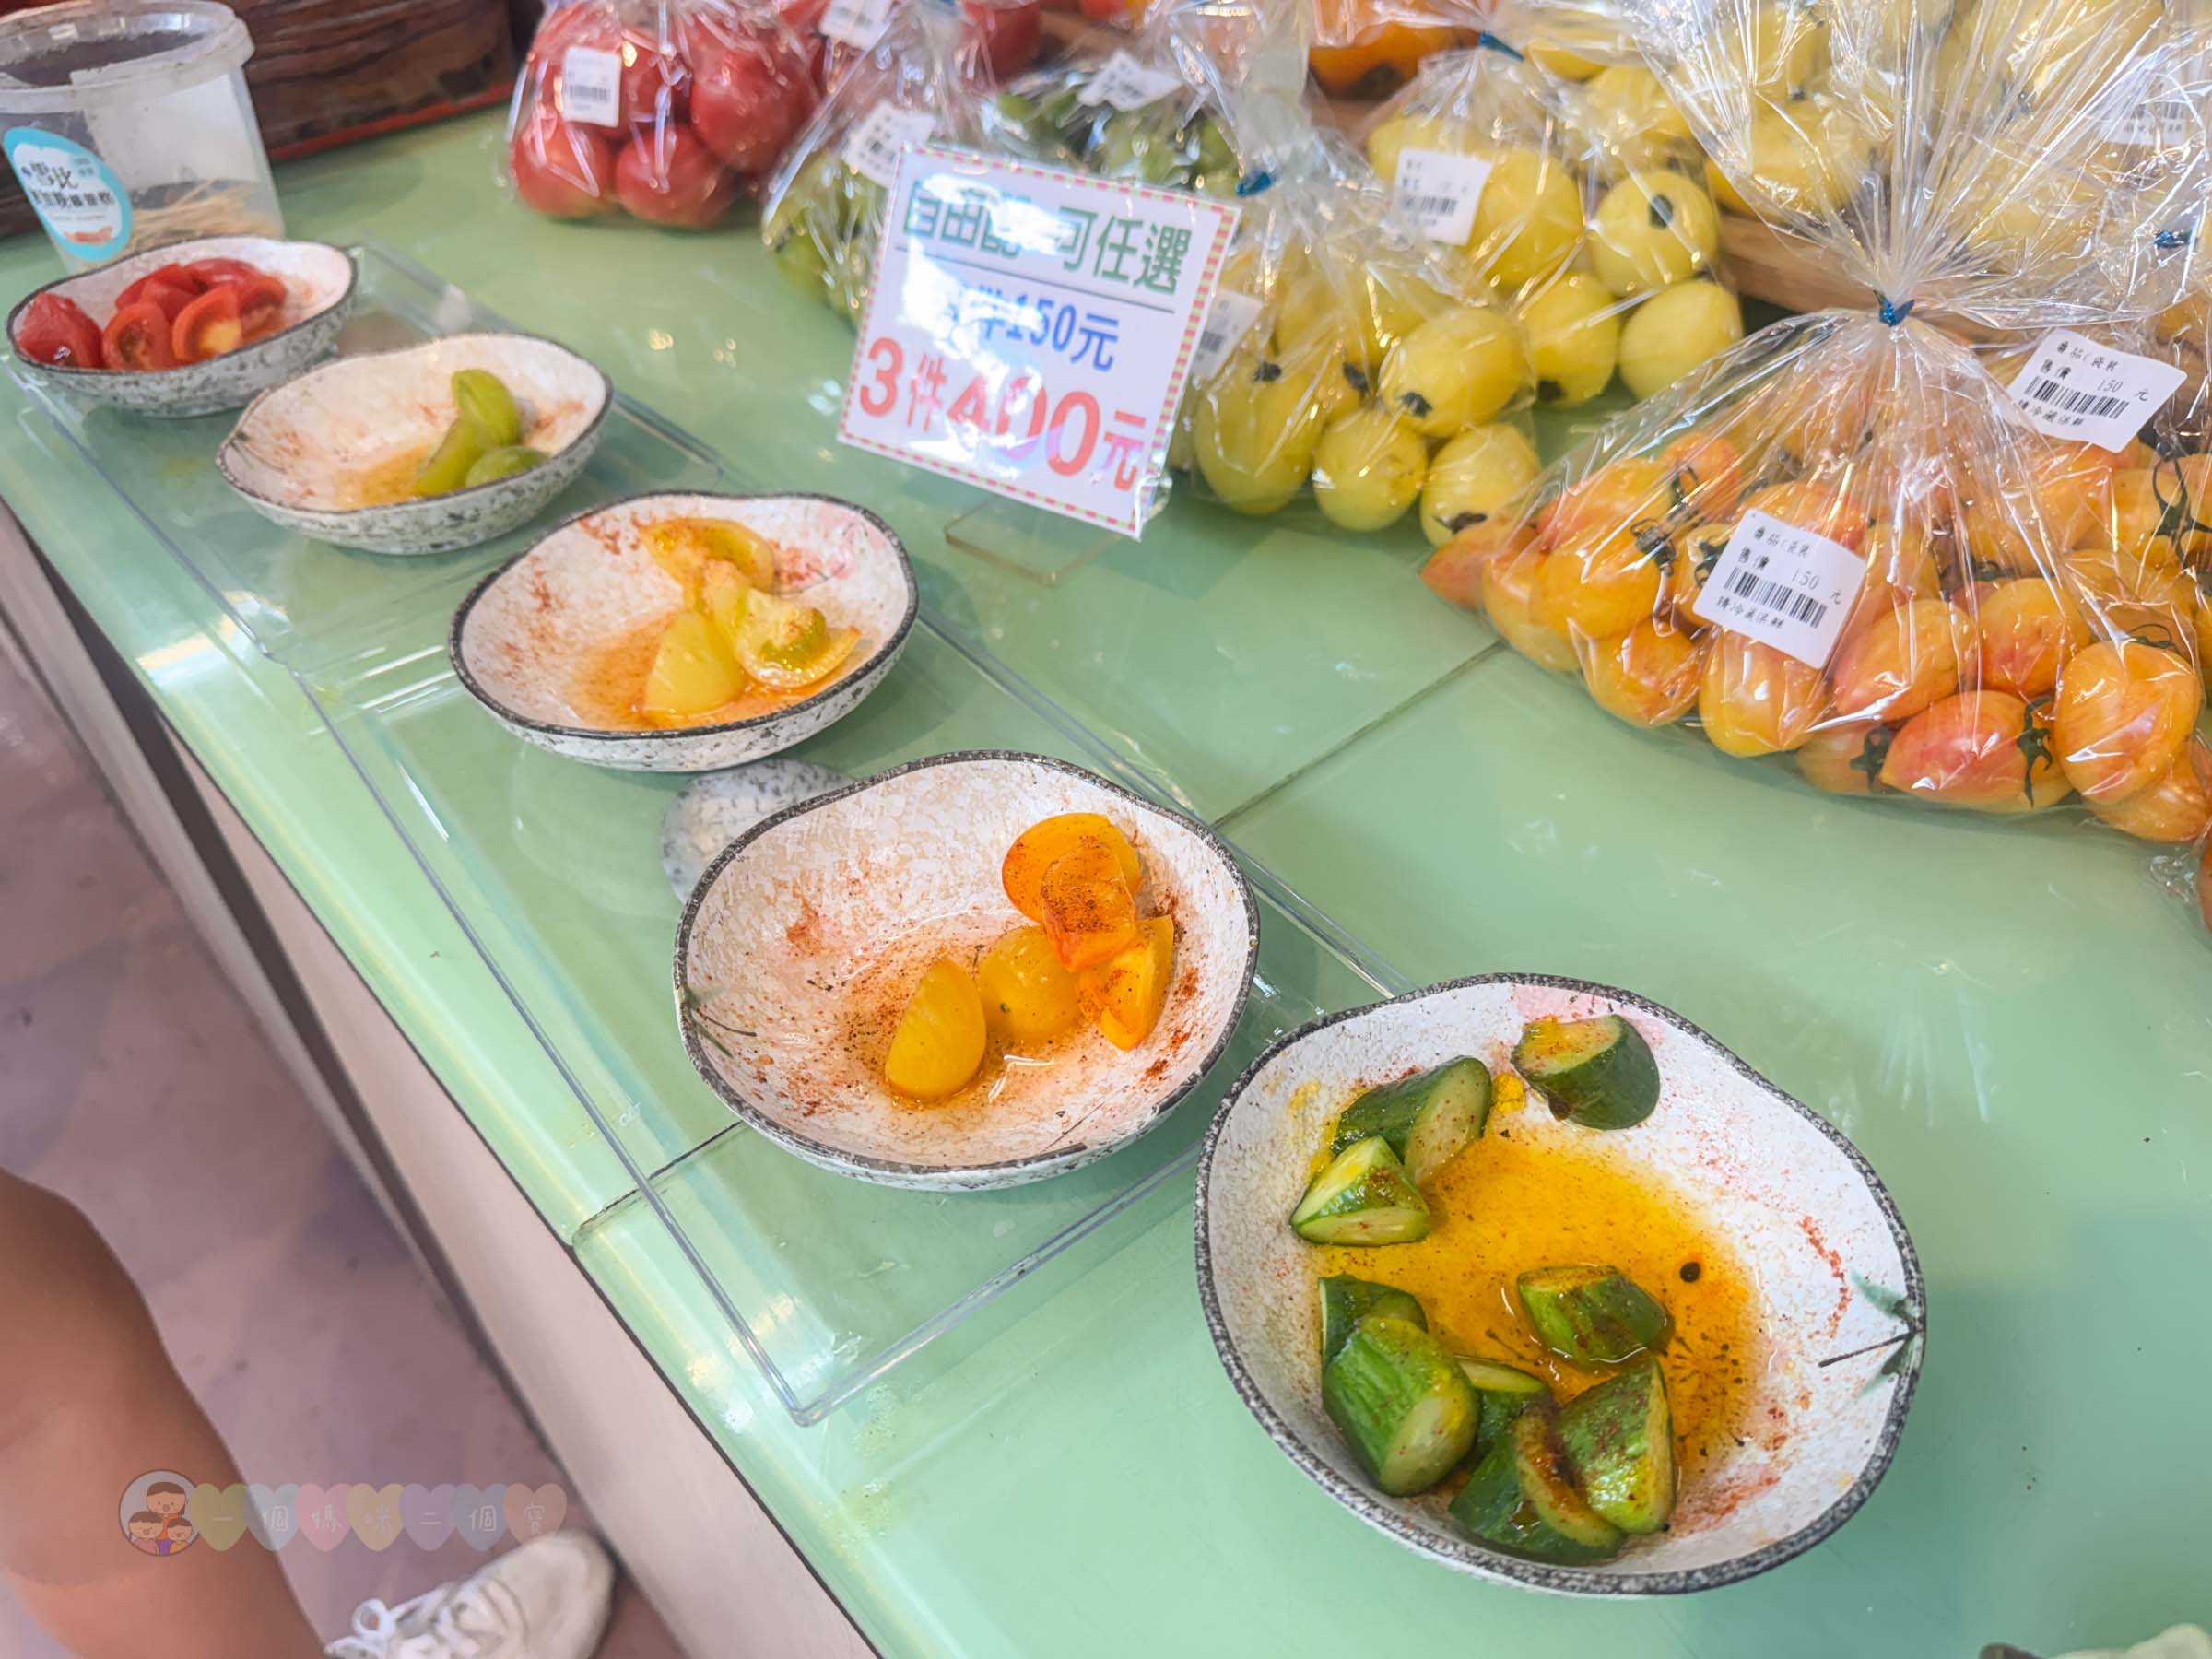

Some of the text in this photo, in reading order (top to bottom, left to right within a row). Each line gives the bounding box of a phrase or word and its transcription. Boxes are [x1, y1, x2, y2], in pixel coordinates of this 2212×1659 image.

[1056, 205, 1192, 296] 可任選
[2097, 378, 2124, 393] 150
[2136, 387, 2149, 402] 元
[1791, 568, 1821, 591] 150
